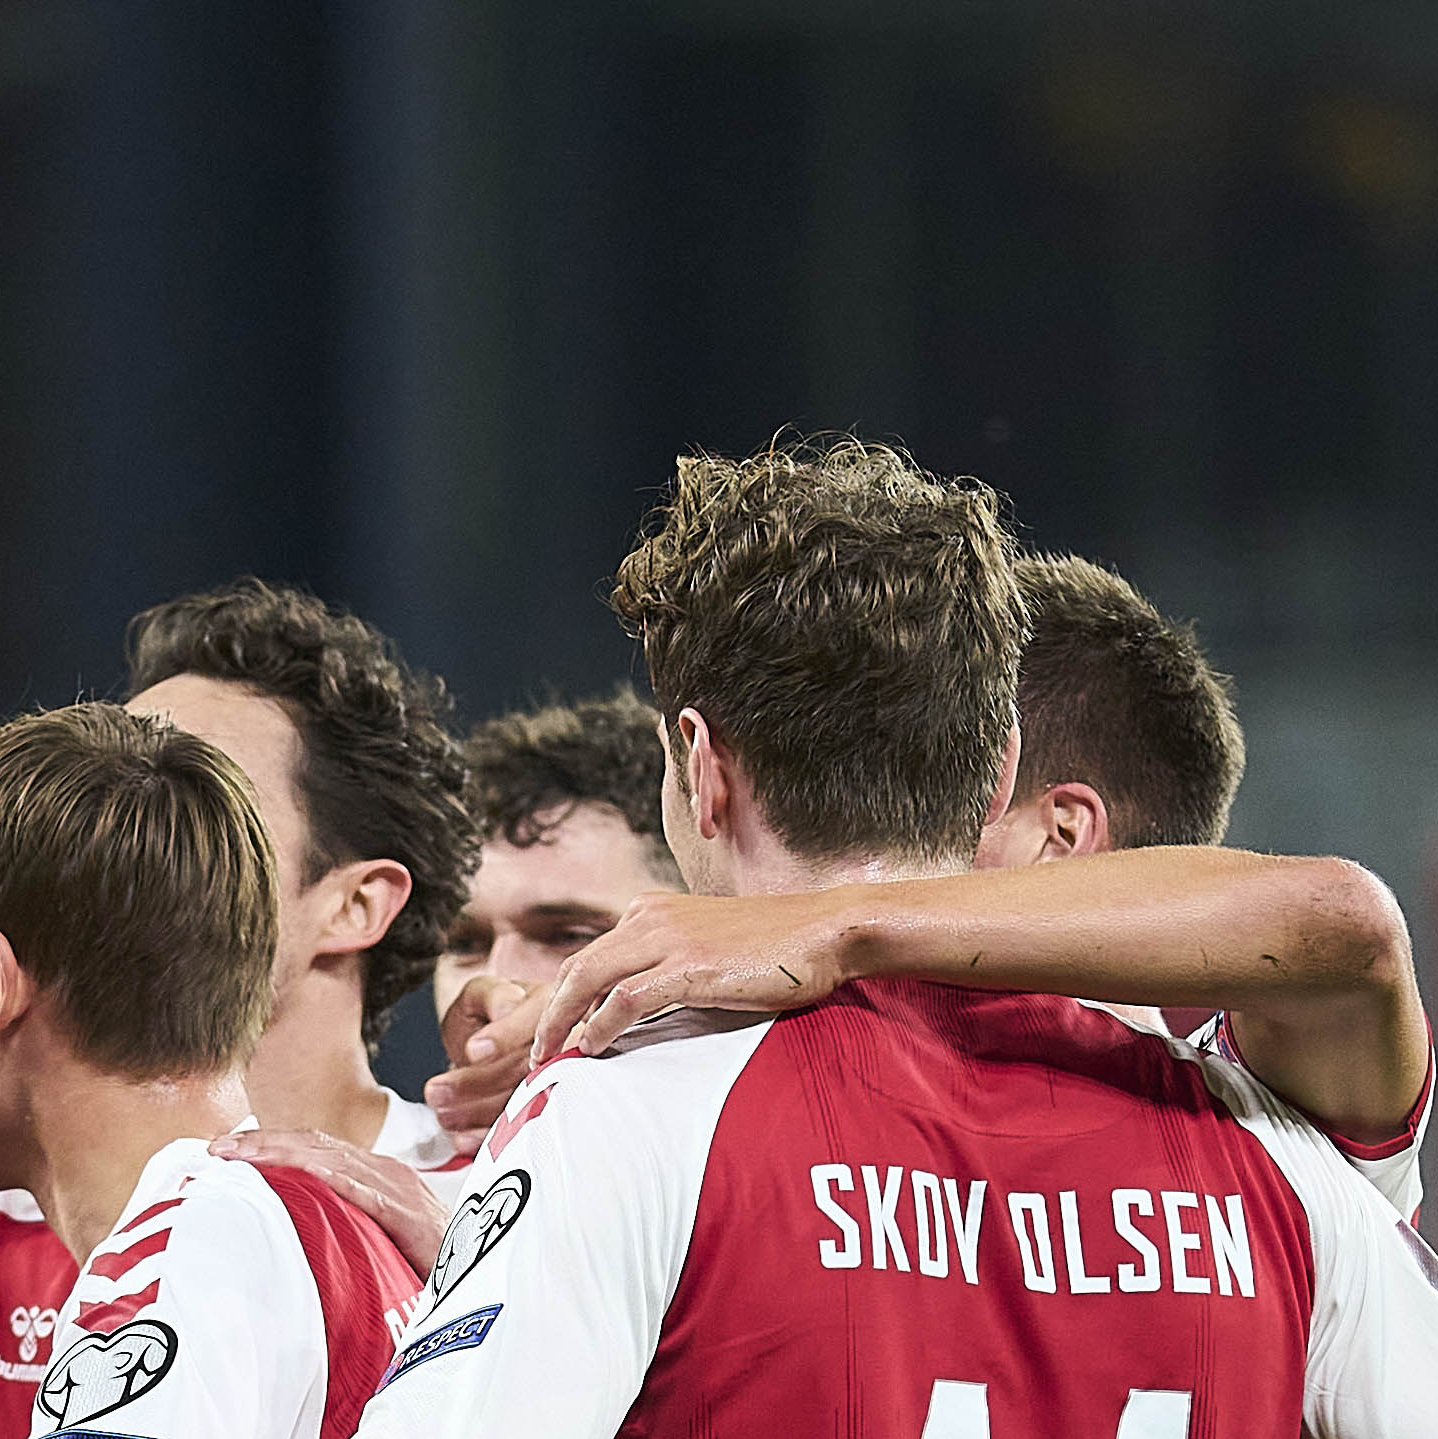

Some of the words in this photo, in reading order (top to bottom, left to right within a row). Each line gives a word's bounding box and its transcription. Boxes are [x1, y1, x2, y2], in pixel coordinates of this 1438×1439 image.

[808, 1163, 988, 1286] SKOV
[1008, 1188, 1256, 1298] OLSEN
[399, 1315, 495, 1369] RESPECT
